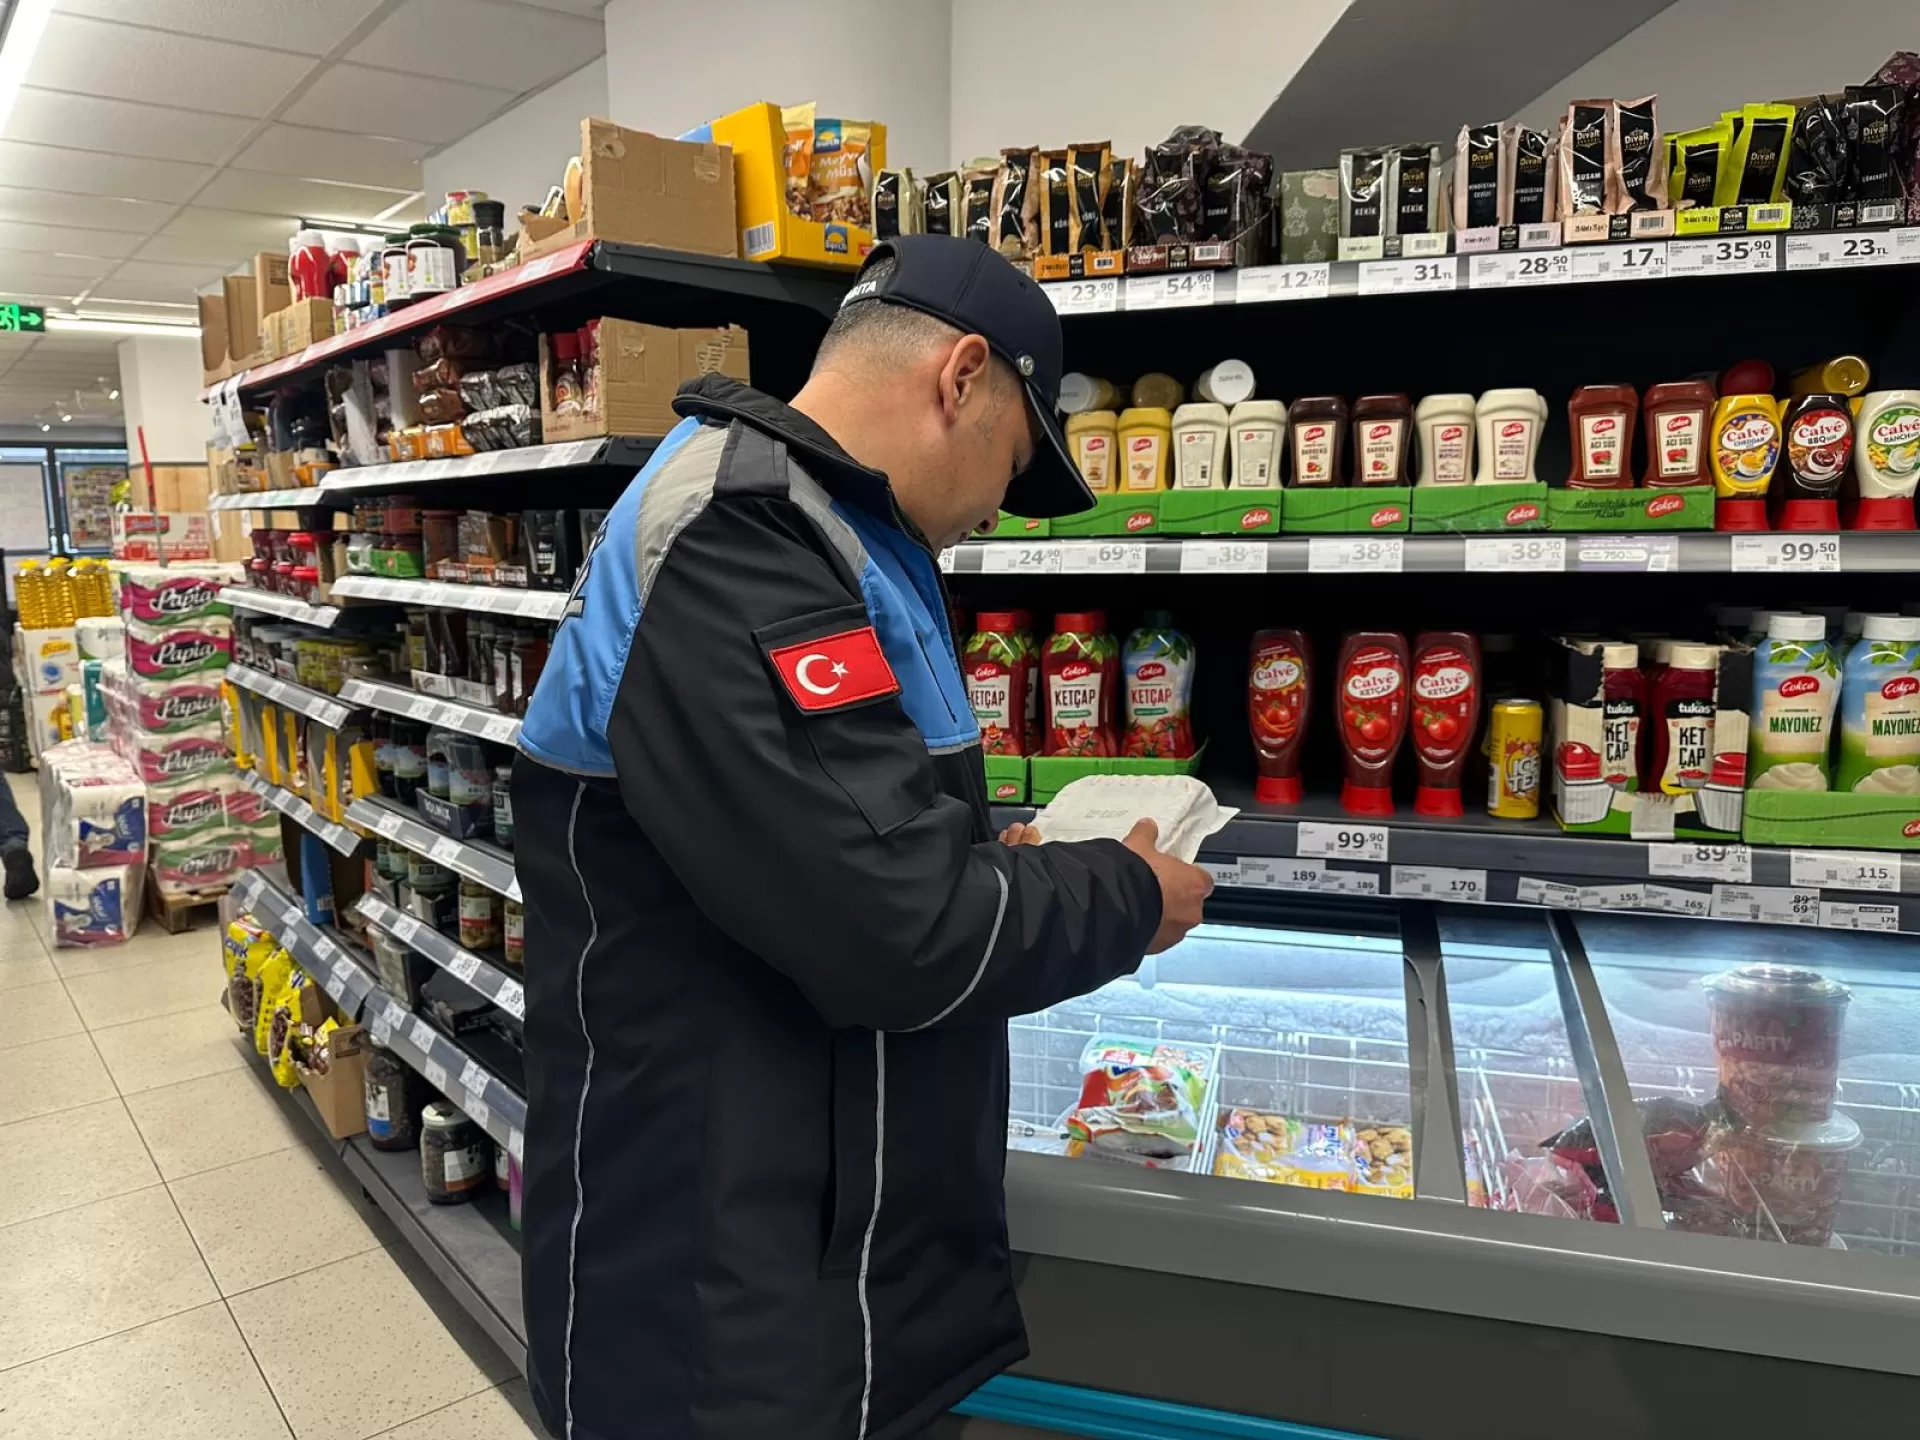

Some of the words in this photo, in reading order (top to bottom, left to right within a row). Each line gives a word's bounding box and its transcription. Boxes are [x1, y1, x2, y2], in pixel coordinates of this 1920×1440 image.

[1760, 251, 1773, 259] TL
[1843, 239, 1876, 257] 23
[1876, 246, 1888, 255] TL
[1623, 247, 1654, 268] 17
[1654, 257, 1667, 265] TL
[1414, 263, 1442, 282] 31
[1557, 264, 1568, 273] TL
[1727, 425, 1769, 443] Calvé
[1798, 420, 1843, 440] Calvé
[1807, 435, 1827, 445] BBQ
[1781, 541, 1837, 563] 99,50
[1825, 552, 1837, 562] TL
[152, 634, 215, 668] Papia
[1351, 673, 1397, 689] Calvé
[1420, 673, 1465, 689] Calvé
[1055, 689, 1096, 709] KETÇAP
[1132, 688, 1172, 707] KETÇAP
[1605, 721, 1629, 743] KET
[1770, 716, 1822, 733] MAYONEZ
[1872, 718, 1920, 736] MAYONEZ
[1679, 727, 1706, 746] KET
[1606, 742, 1629, 763] ÇAP
[1679, 748, 1706, 769] ÇAP
[1338, 831, 1385, 849] 99,90
[1736, 855, 1747, 864] TL
[1292, 871, 1317, 882] 189
[1858, 867, 1888, 879] 115
[1450, 881, 1477, 892] 170
